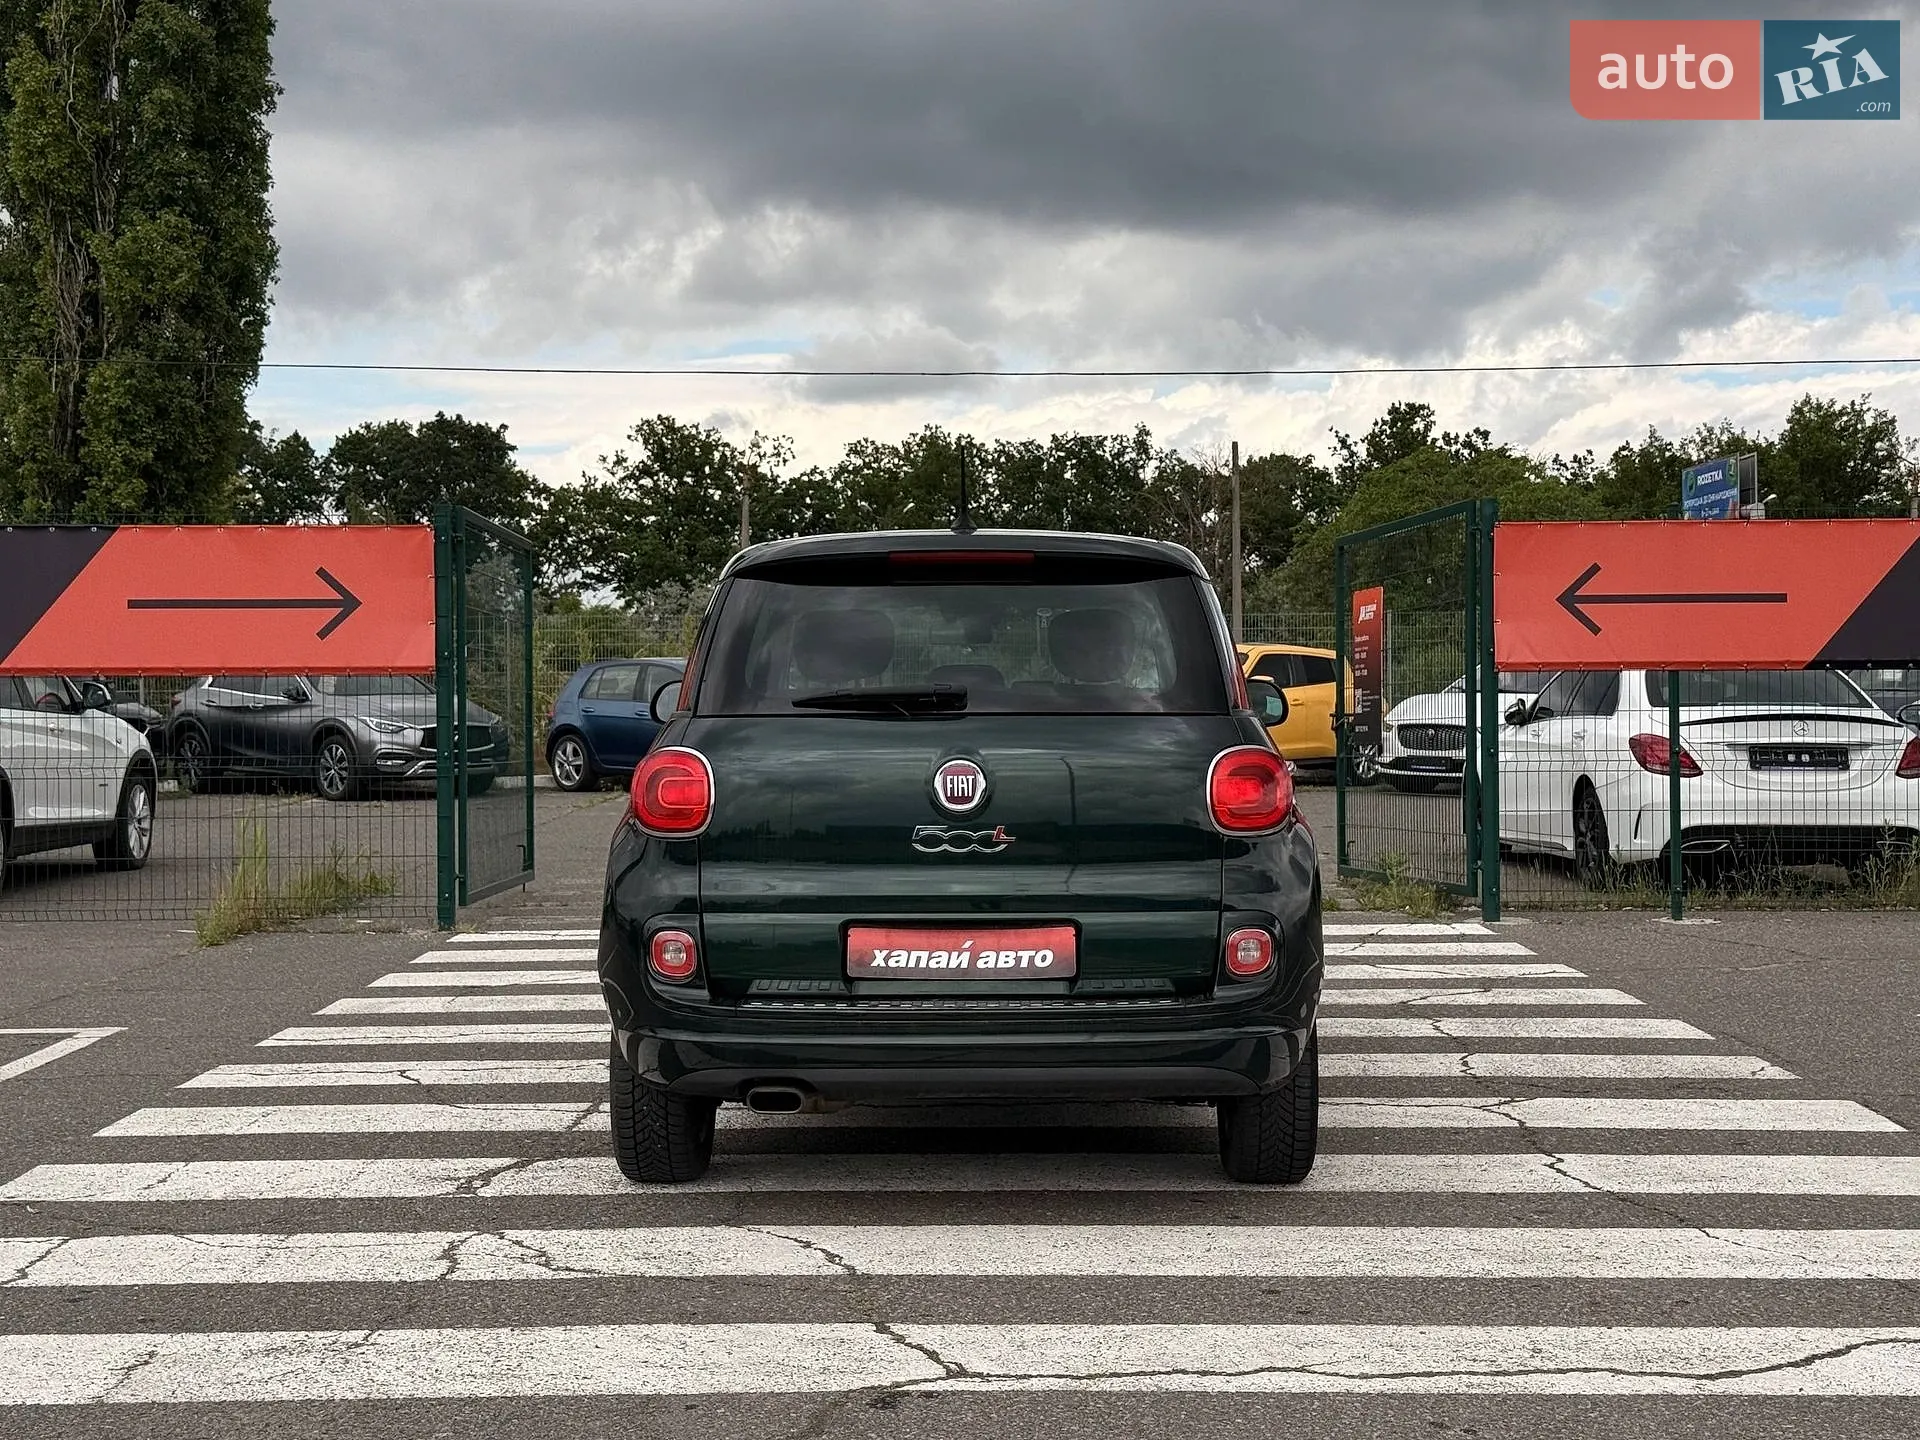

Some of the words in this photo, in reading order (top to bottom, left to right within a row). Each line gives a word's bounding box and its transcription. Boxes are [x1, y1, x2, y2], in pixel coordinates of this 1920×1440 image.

[1697, 470, 1723, 486] ROZETKA
[946, 775, 975, 797] FIAT
[911, 825, 1017, 853] 500L
[976, 949, 1054, 969] авто
